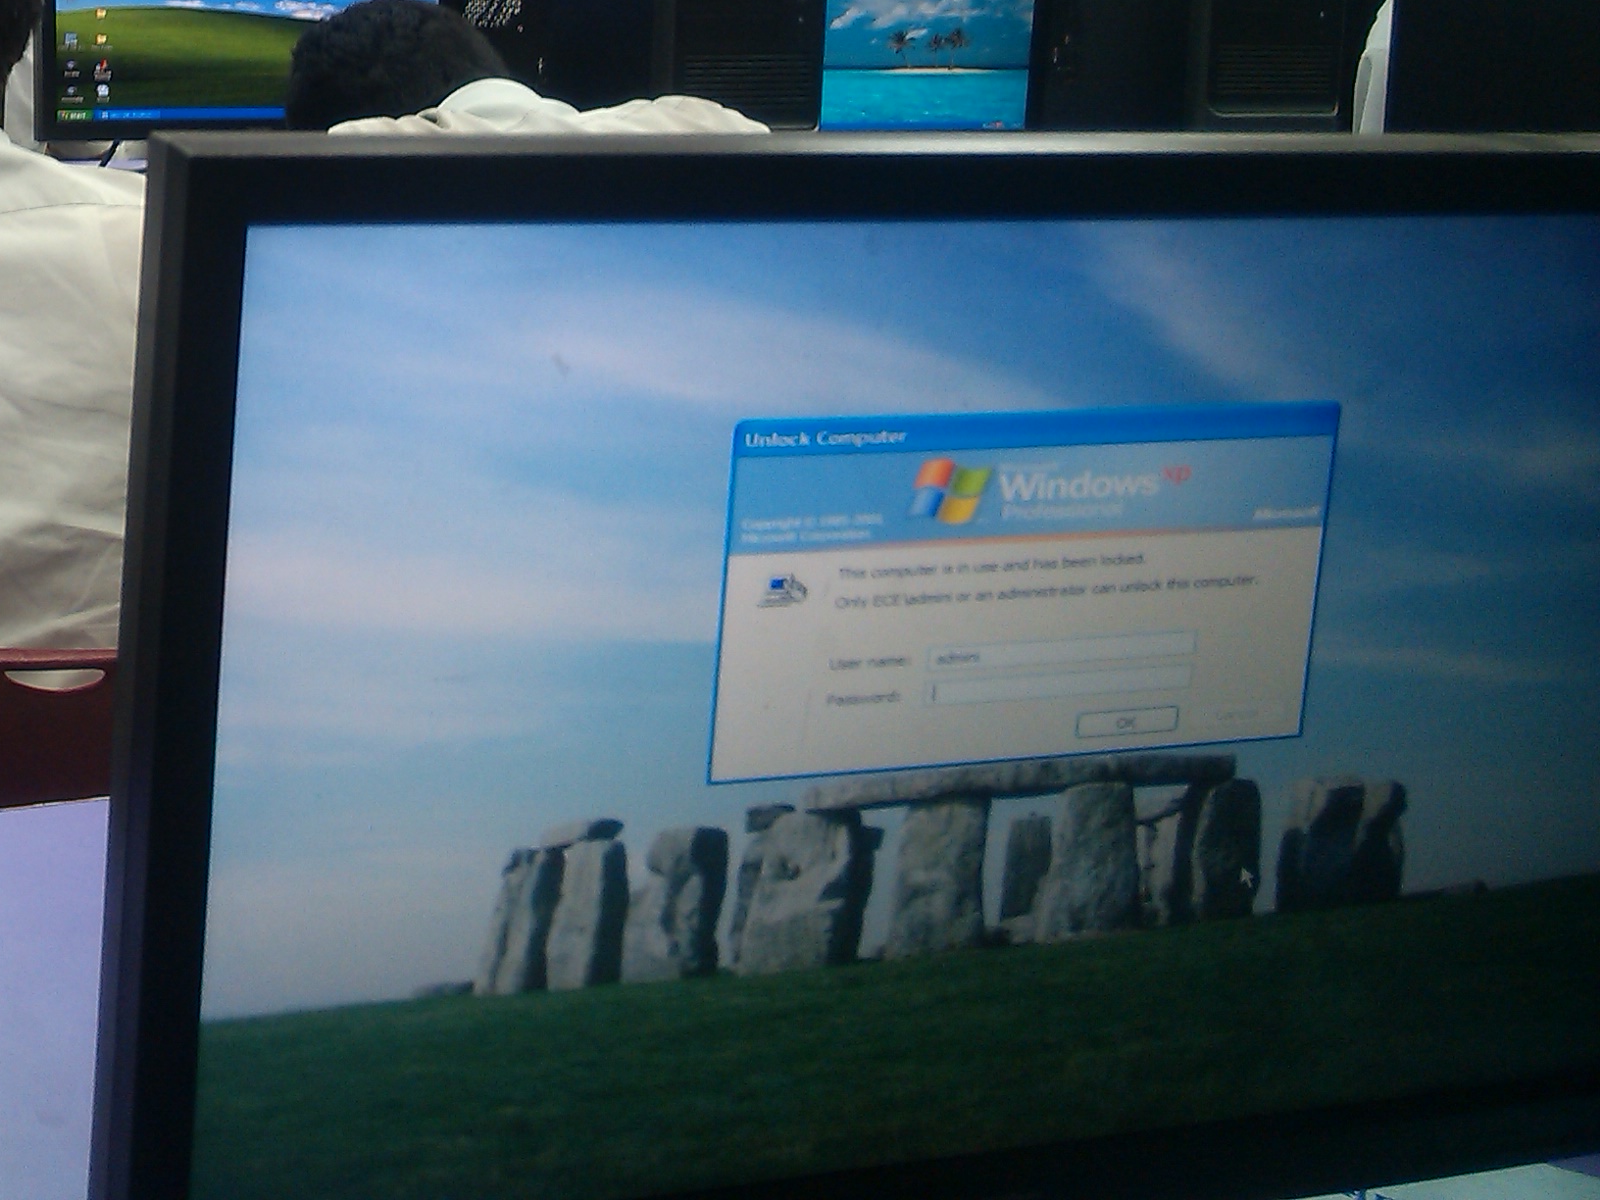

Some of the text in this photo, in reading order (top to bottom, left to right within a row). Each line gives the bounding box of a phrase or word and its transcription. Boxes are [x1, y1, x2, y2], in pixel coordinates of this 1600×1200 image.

[744, 429, 907, 448] Unlock Computer
[999, 467, 1160, 502] Windows
[870, 565, 938, 581] computer
[1002, 558, 1030, 573] and
[1032, 557, 1058, 571] has
[1061, 555, 1097, 569] been
[996, 583, 1086, 602] administrator
[1090, 583, 1117, 596] can
[1119, 578, 1162, 594] unlock
[1165, 575, 1191, 590] this
[1115, 716, 1138, 730] OK
